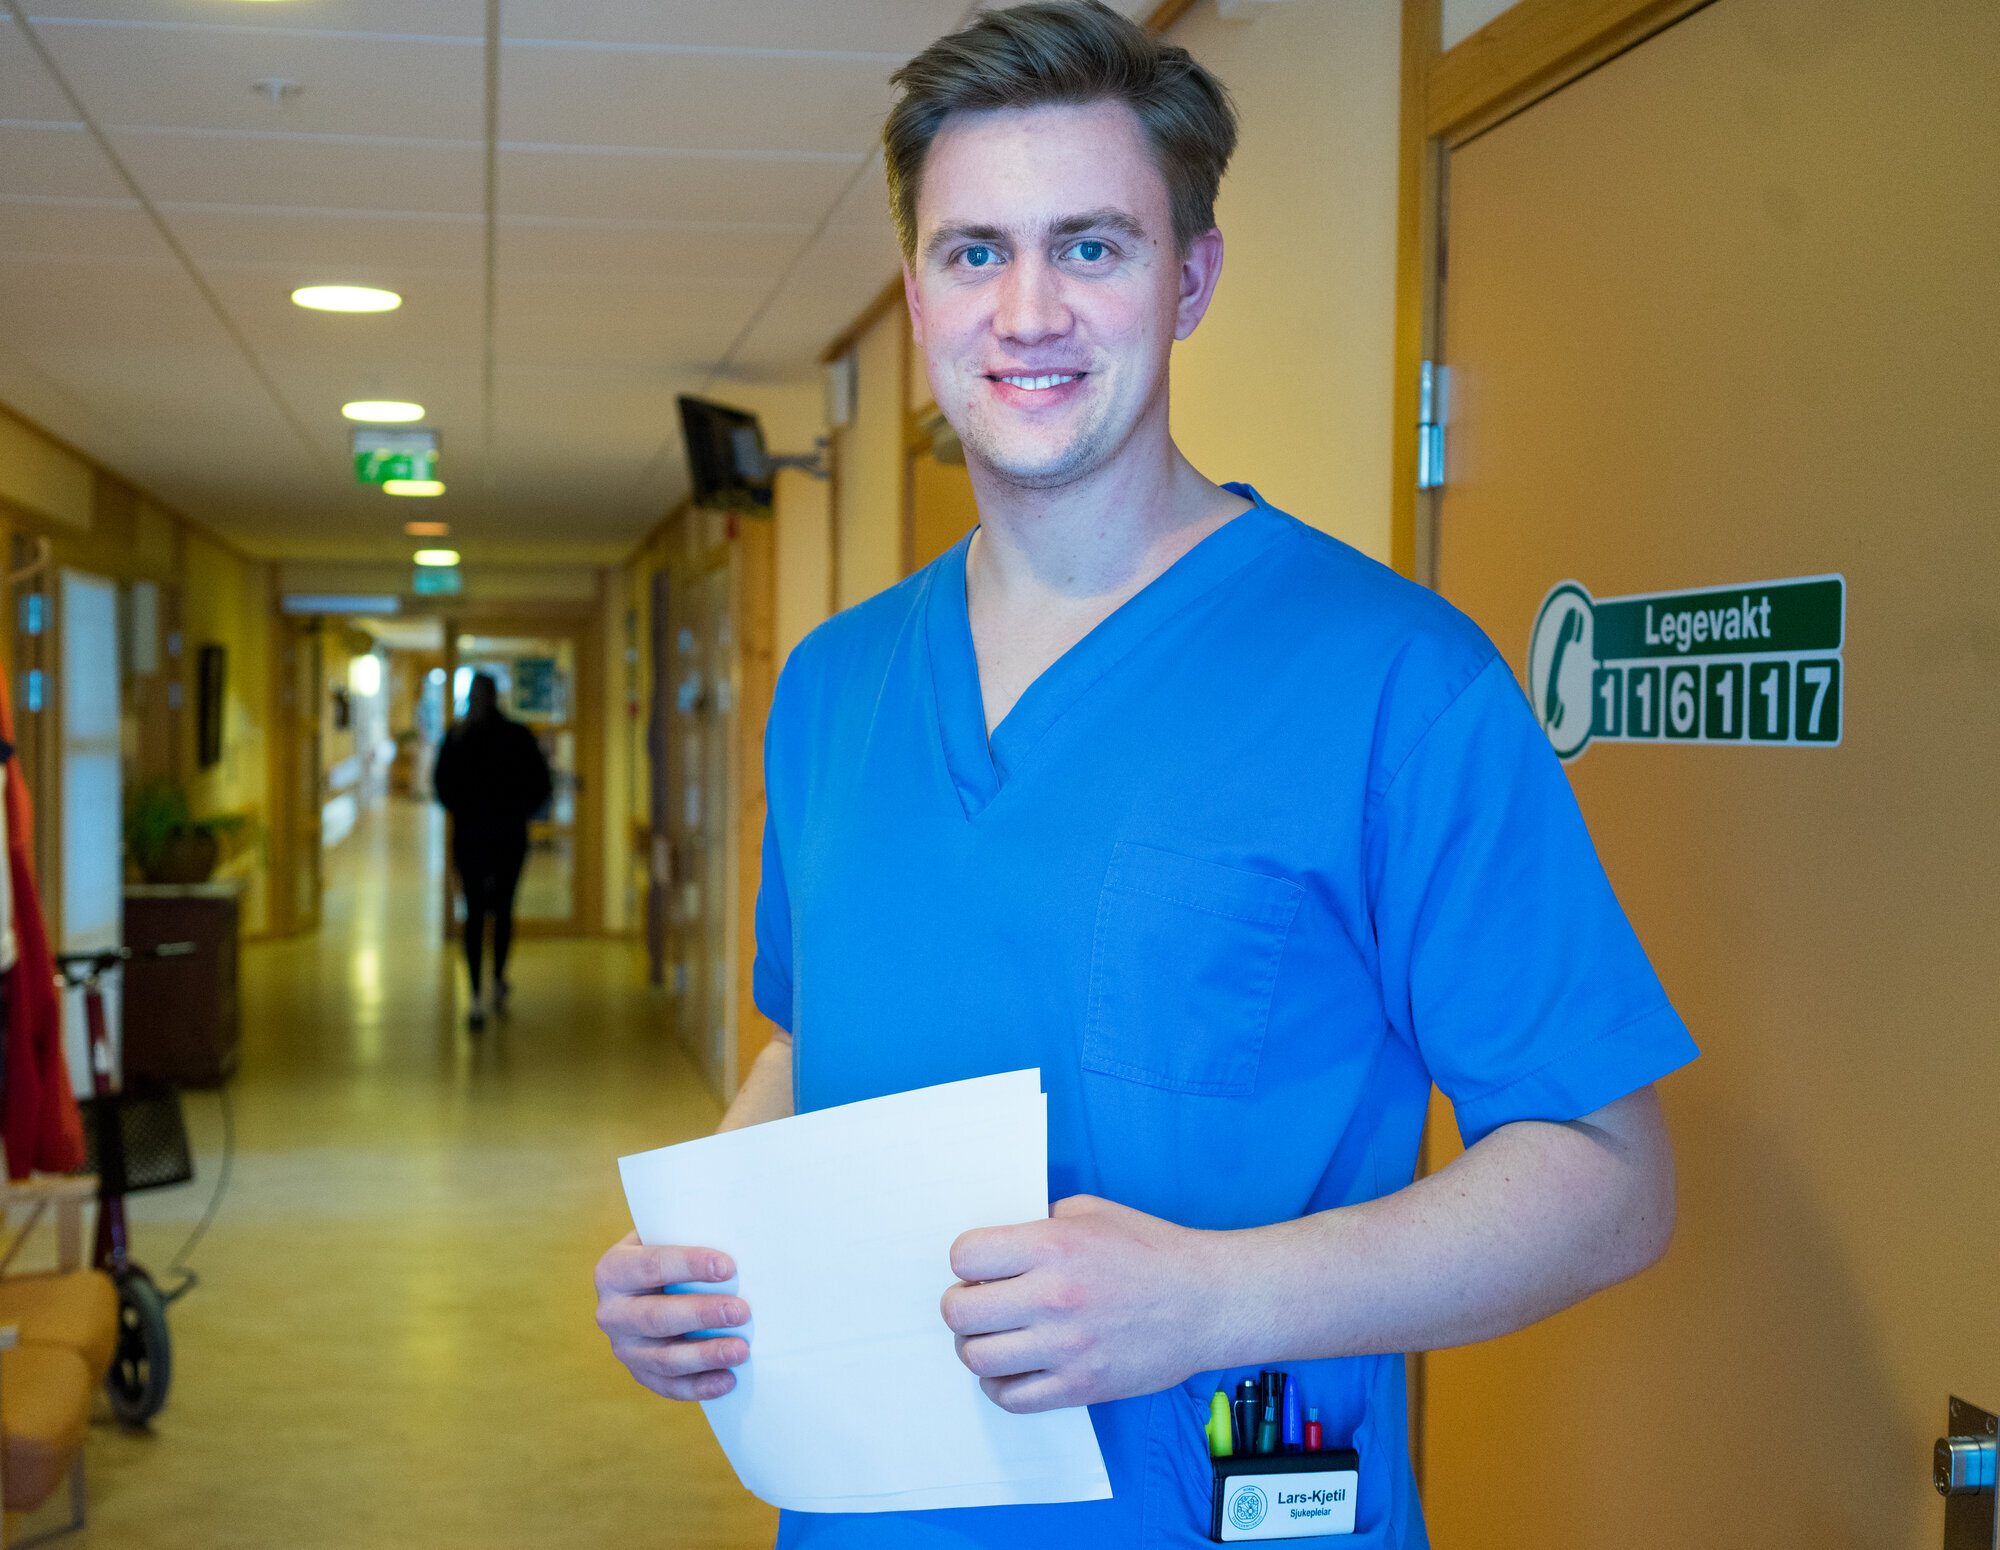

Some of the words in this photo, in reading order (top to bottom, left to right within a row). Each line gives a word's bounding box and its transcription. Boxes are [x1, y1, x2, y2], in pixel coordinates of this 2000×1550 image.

[1645, 596, 1771, 652] Legevakt
[1278, 1489, 1345, 1505] Lars-Kjetil
[1290, 1508, 1331, 1519] Sjukepleiar
